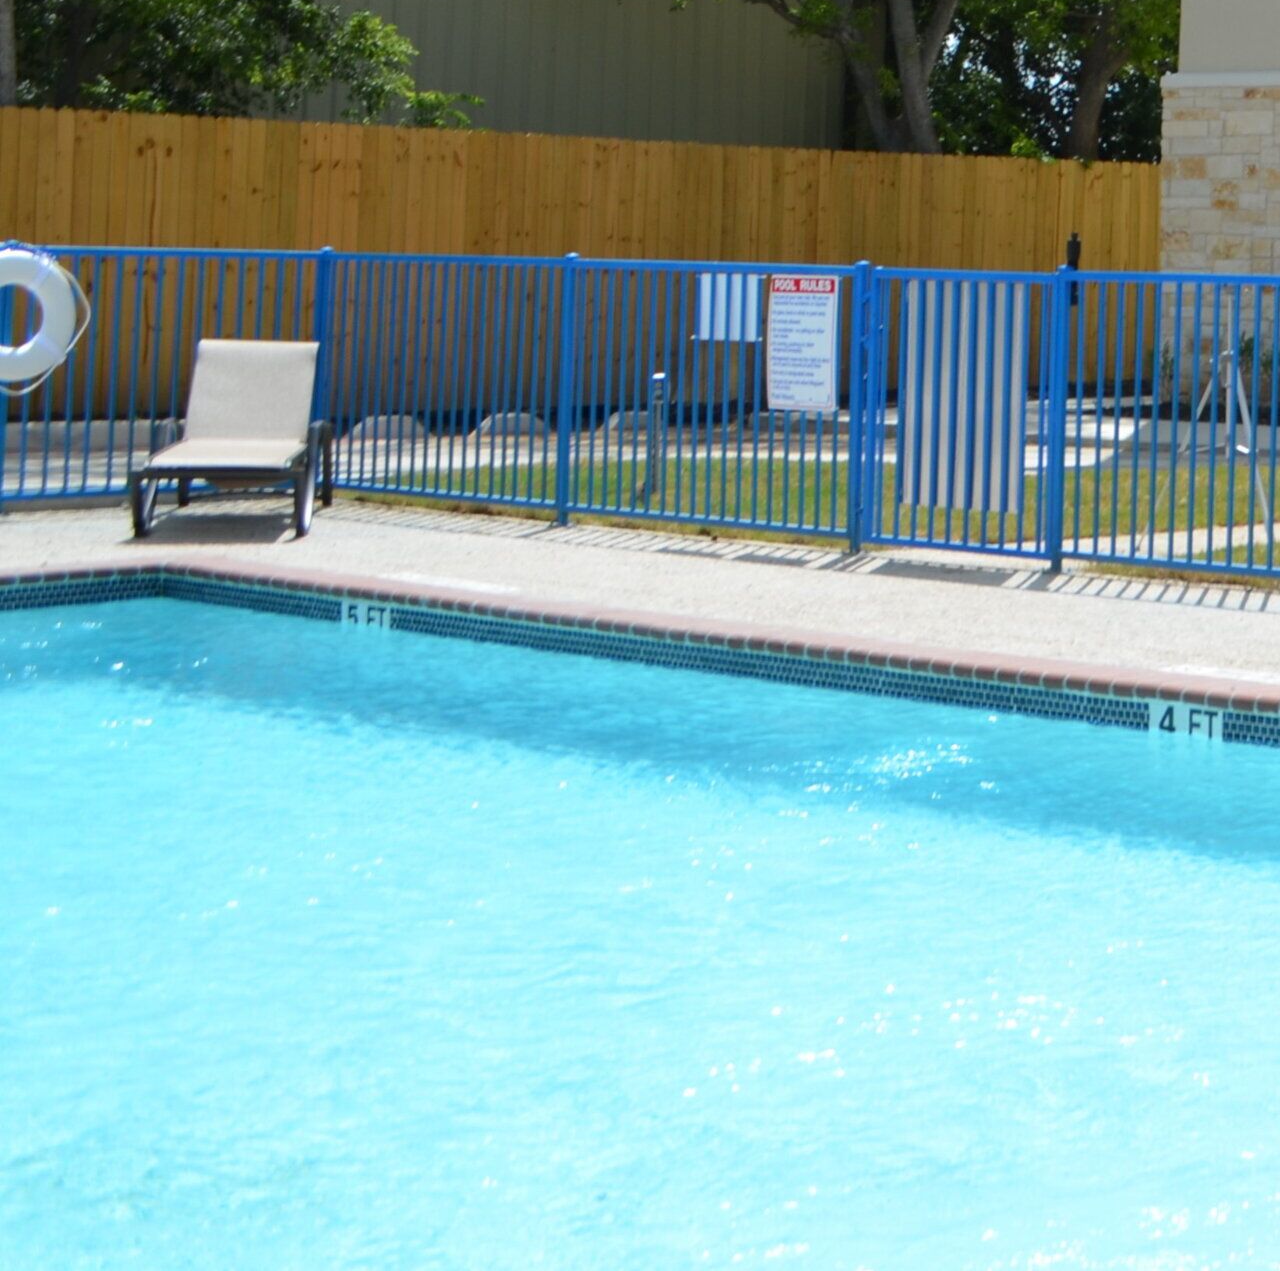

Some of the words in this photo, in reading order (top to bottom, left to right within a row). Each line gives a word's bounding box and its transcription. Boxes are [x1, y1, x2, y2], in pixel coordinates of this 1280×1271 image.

[774, 279, 798, 291] POOL
[799, 279, 832, 292] RULES
[348, 605, 359, 624] 5
[366, 605, 387, 628] FT
[1158, 705, 1176, 733] 4
[1188, 708, 1218, 739] FT
